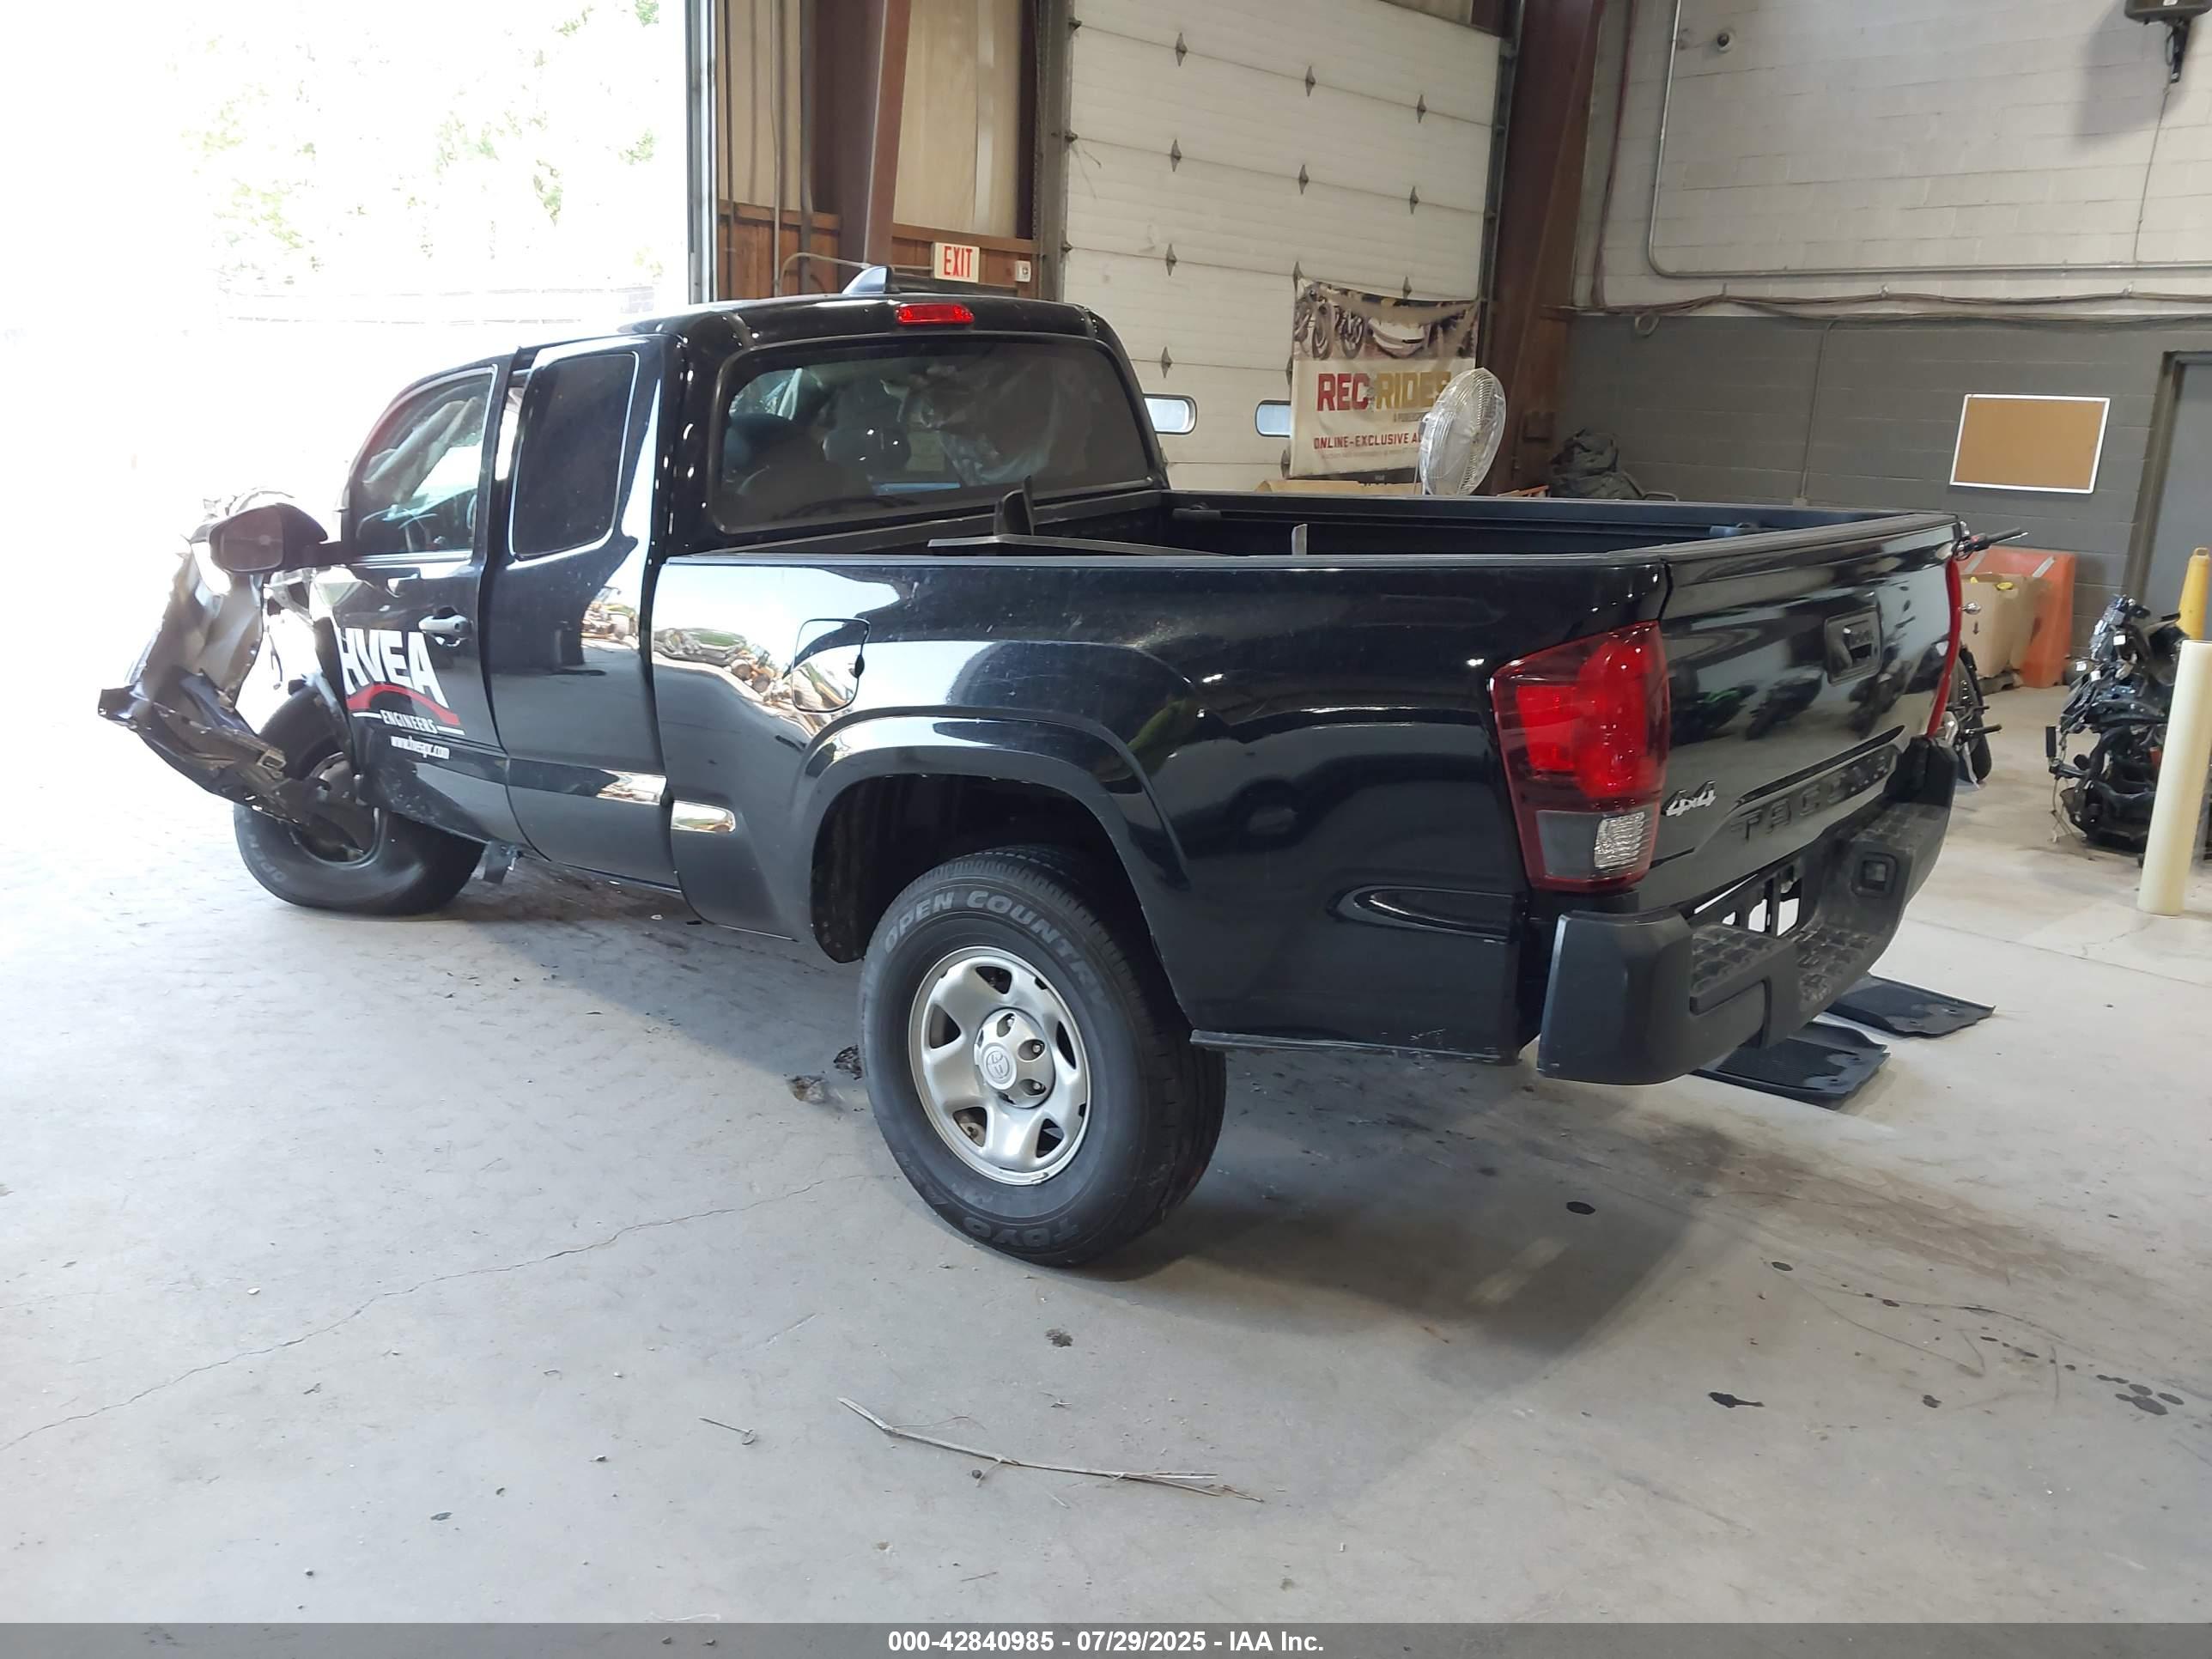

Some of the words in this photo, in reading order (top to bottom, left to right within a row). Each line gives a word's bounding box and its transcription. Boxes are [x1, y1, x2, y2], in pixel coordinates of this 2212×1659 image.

[944, 246, 973, 277] EXIT
[1316, 373, 1370, 411] REC
[1314, 433, 1409, 449] ONLINE-EXCLUSIVE
[337, 628, 449, 708] HVEA
[380, 709, 439, 734] ENGINEERS
[1663, 780, 1717, 817] 4x4
[1730, 756, 1890, 839] TACO
[884, 891, 955, 954] OPEN
[966, 890, 1114, 1009] COUNTRY
[963, 1216, 1080, 1248] TOYO
